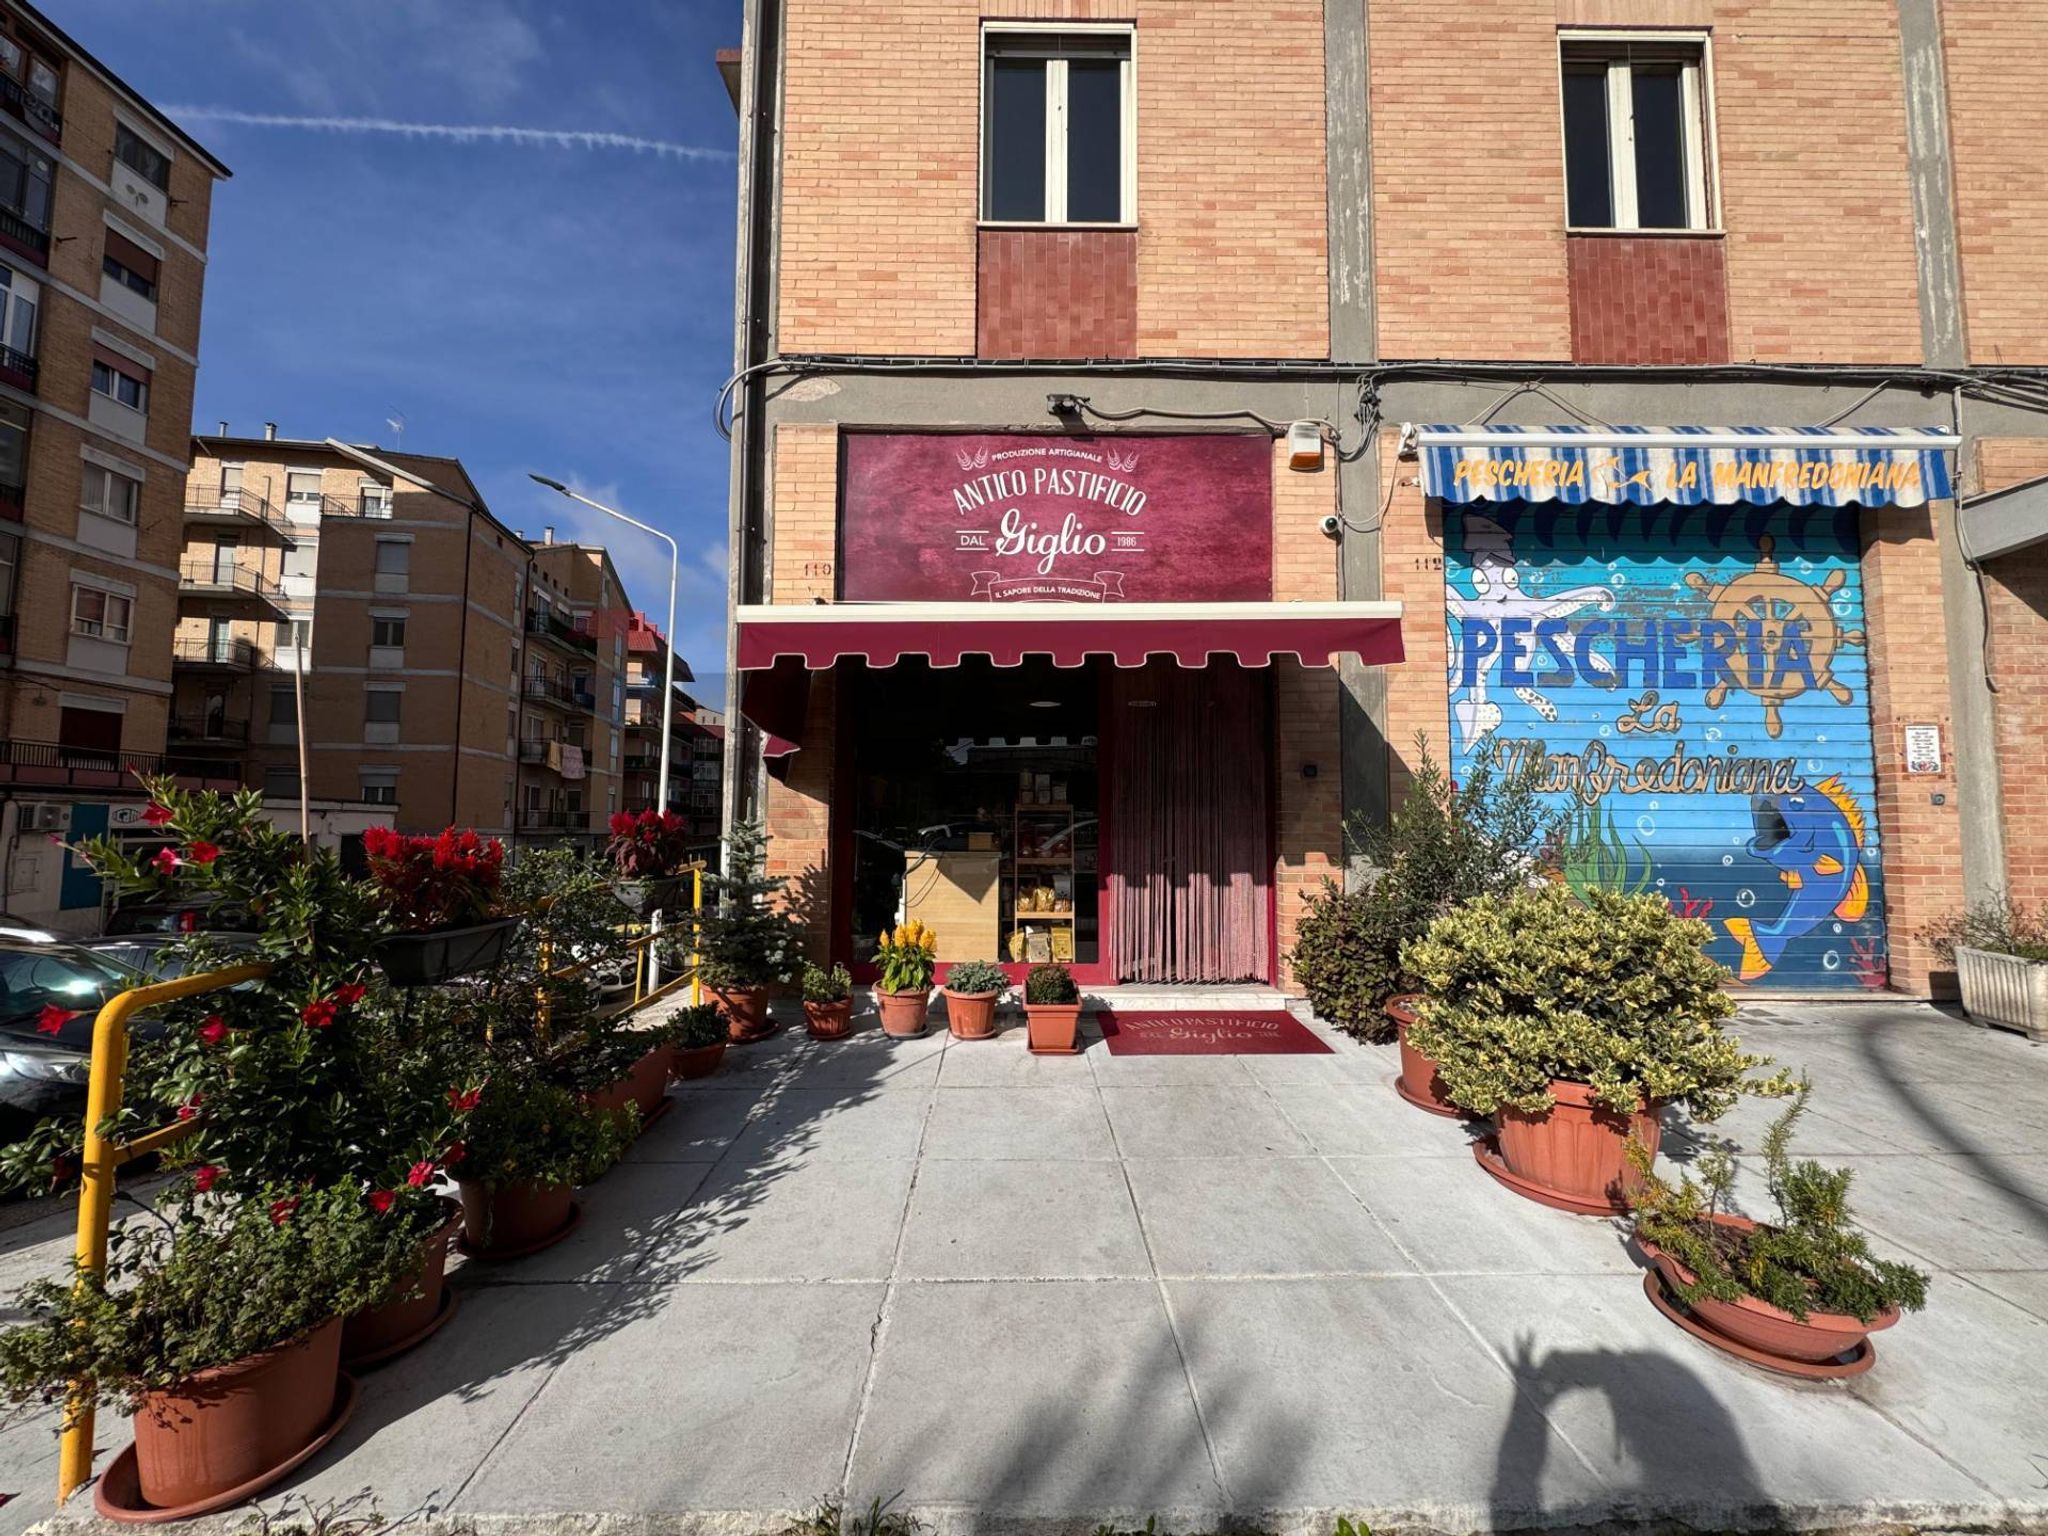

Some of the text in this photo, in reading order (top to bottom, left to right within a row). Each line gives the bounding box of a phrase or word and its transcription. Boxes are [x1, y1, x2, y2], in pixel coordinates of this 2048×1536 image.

[992, 448, 1103, 463] PRODUZIONE ARTIGIANALE
[953, 468, 1147, 516] ANTICO PASTIFICIO
[1454, 459, 1920, 490] PESCHERIA LA MANFREDONIANA
[960, 508, 1137, 575] DAL Giglio 1986
[1003, 586, 1031, 597] SAPORE
[1033, 586, 1055, 594] DELLA
[1057, 587, 1101, 600] TRADIZIONE
[1462, 617, 1819, 689] PESCHERIA
[1616, 690, 1682, 734] La
[1169, 1027, 1252, 1043] Giglio
